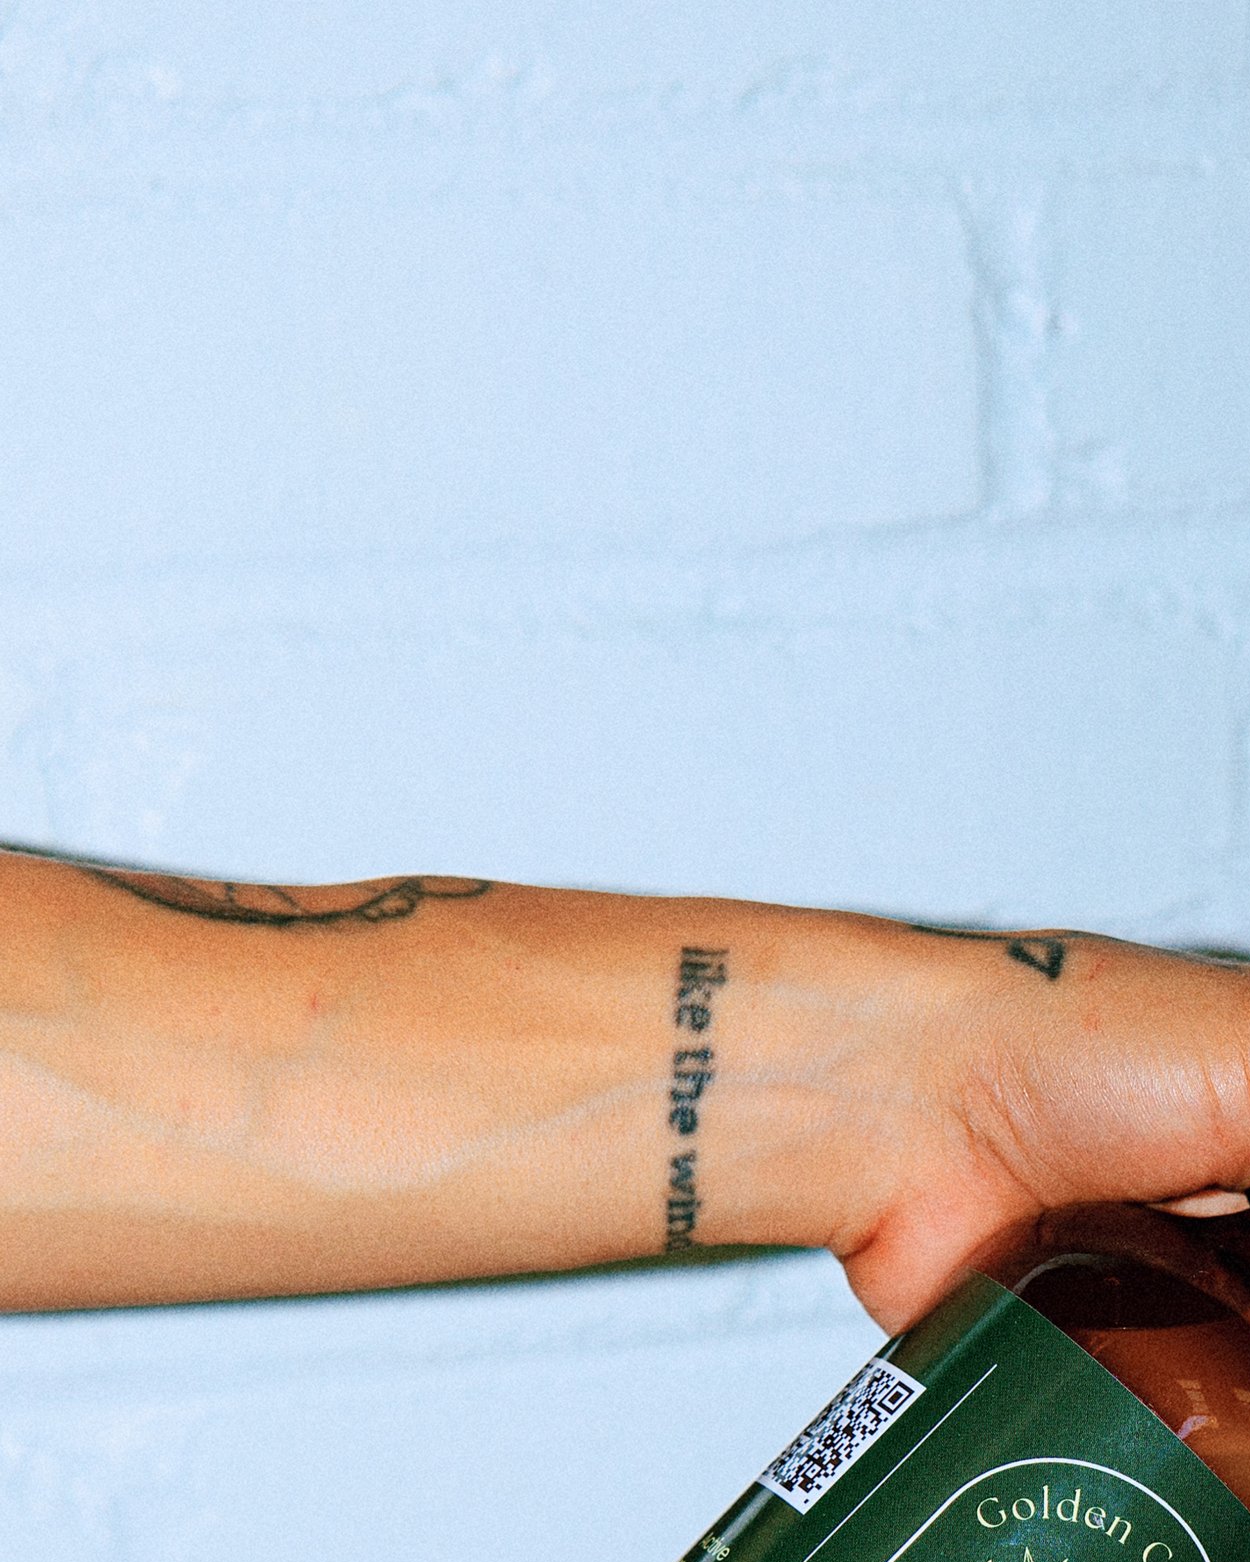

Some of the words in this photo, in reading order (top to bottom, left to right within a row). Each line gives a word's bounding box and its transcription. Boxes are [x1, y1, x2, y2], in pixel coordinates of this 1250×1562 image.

[676, 945, 729, 1034] like
[669, 1048, 714, 1136] the
[976, 1484, 1133, 1545] Golden
